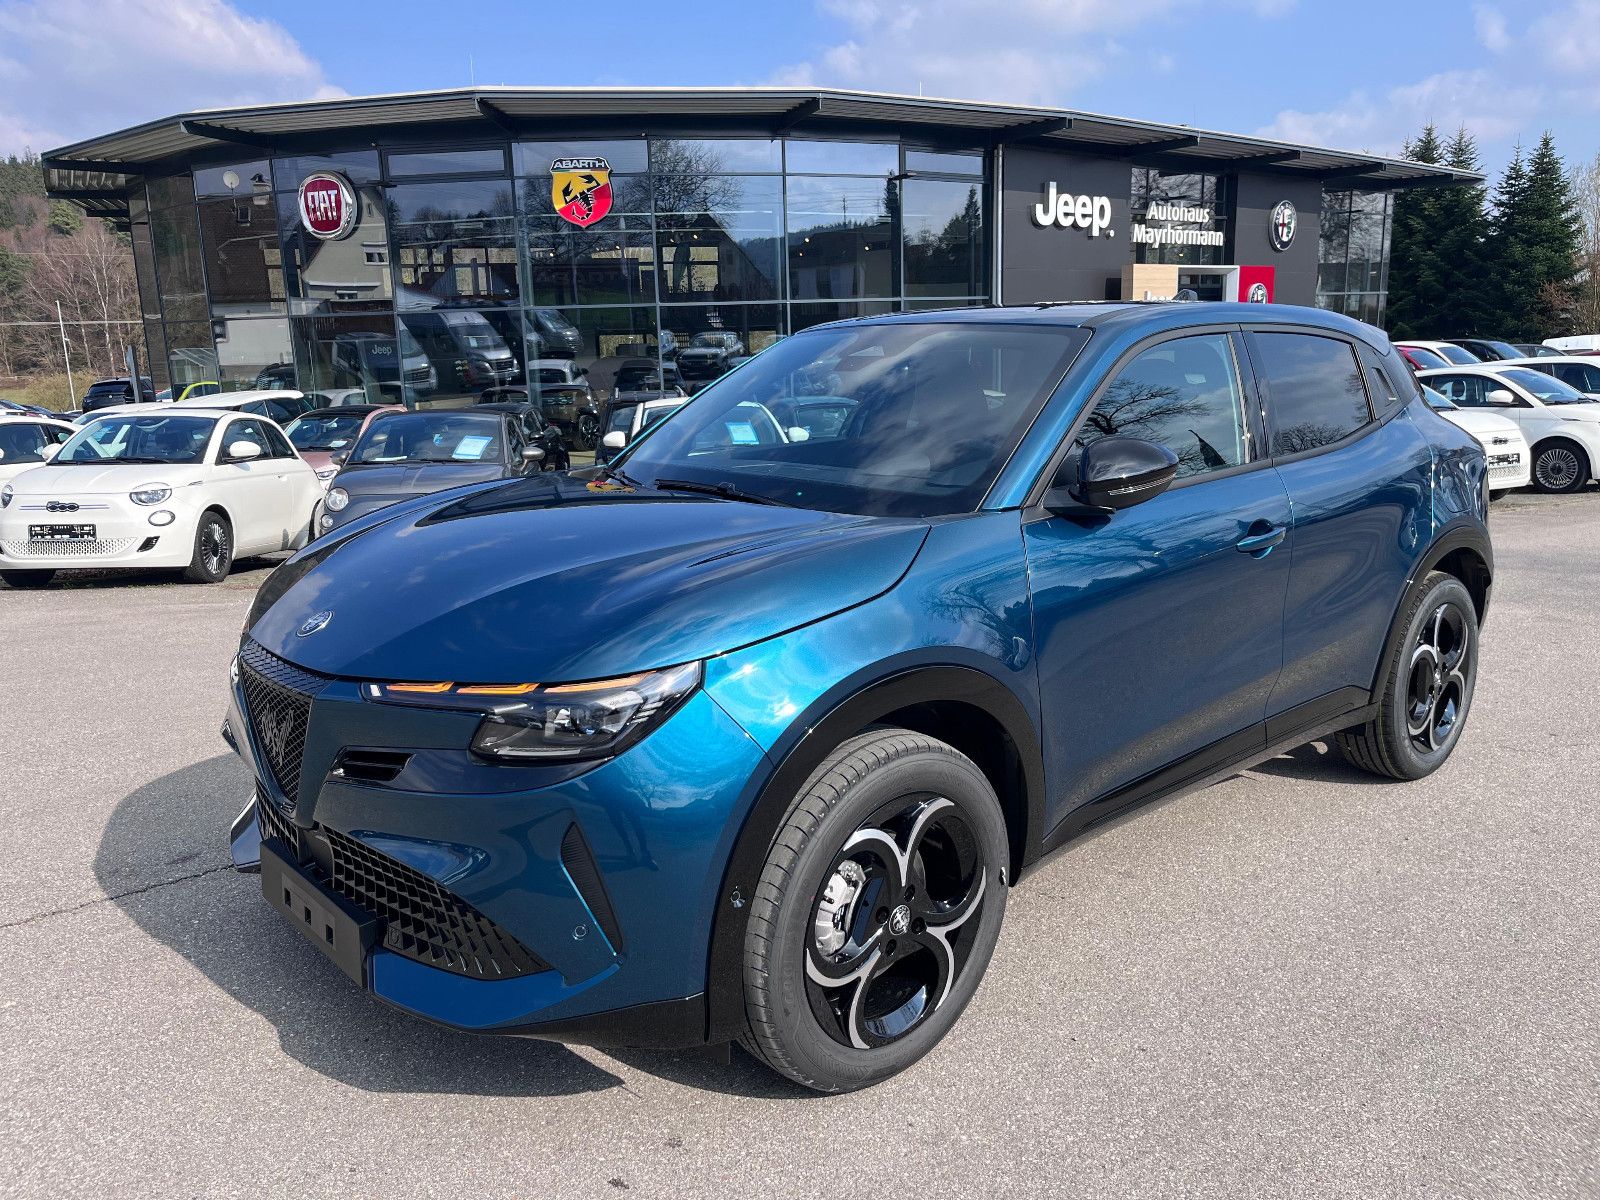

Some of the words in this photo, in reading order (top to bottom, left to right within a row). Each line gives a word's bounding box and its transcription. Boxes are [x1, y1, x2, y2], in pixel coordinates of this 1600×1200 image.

[554, 159, 605, 169] ABARTH
[306, 189, 338, 221] FIAT
[1035, 181, 1112, 236] Jeep
[1147, 200, 1210, 223] Autohaus
[1132, 223, 1224, 249] Mayrhörmann
[371, 344, 393, 356] Jeep
